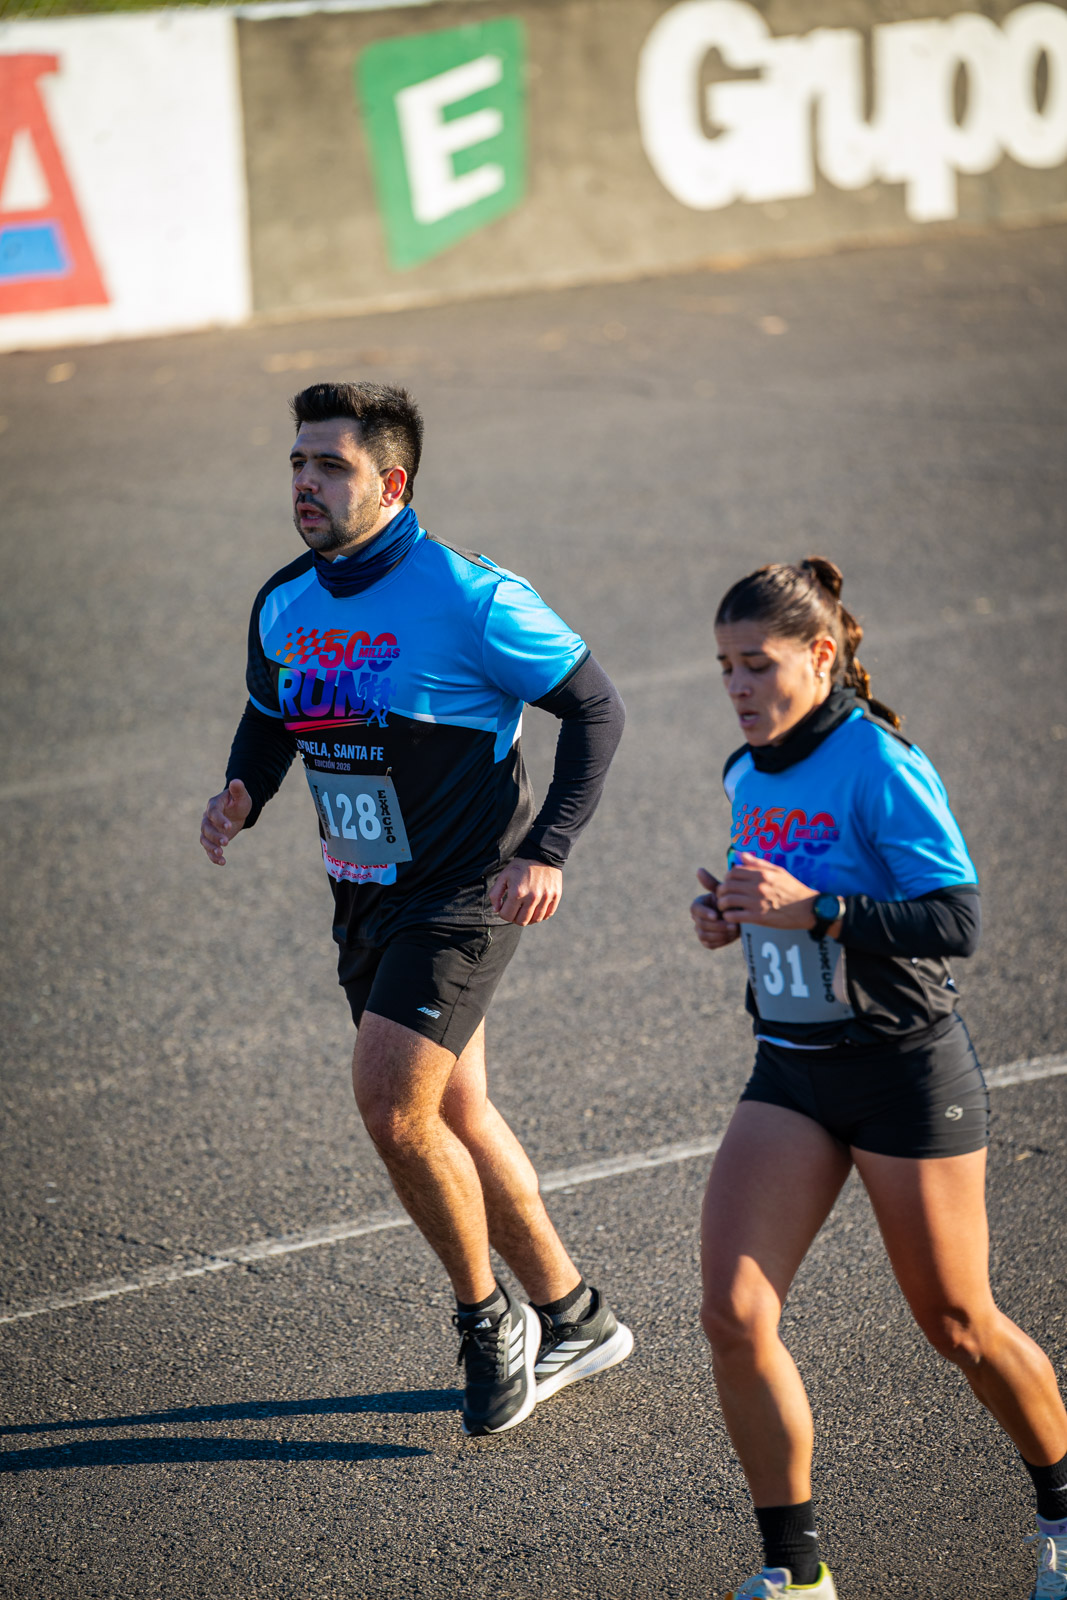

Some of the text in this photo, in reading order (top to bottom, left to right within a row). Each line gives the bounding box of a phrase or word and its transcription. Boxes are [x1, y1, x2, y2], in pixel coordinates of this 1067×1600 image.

[636, 0, 1067, 223] Grupo
[394, 53, 505, 225] E
[358, 646, 401, 659] MILLAS
[278, 667, 371, 718] RUN
[314, 759, 351, 771] EDICIÓN 2026
[333, 743, 368, 761] SANTA
[370, 746, 384, 761] FE
[321, 791, 382, 841] 128
[377, 790, 396, 844] EXACTO
[761, 942, 810, 998] 31
